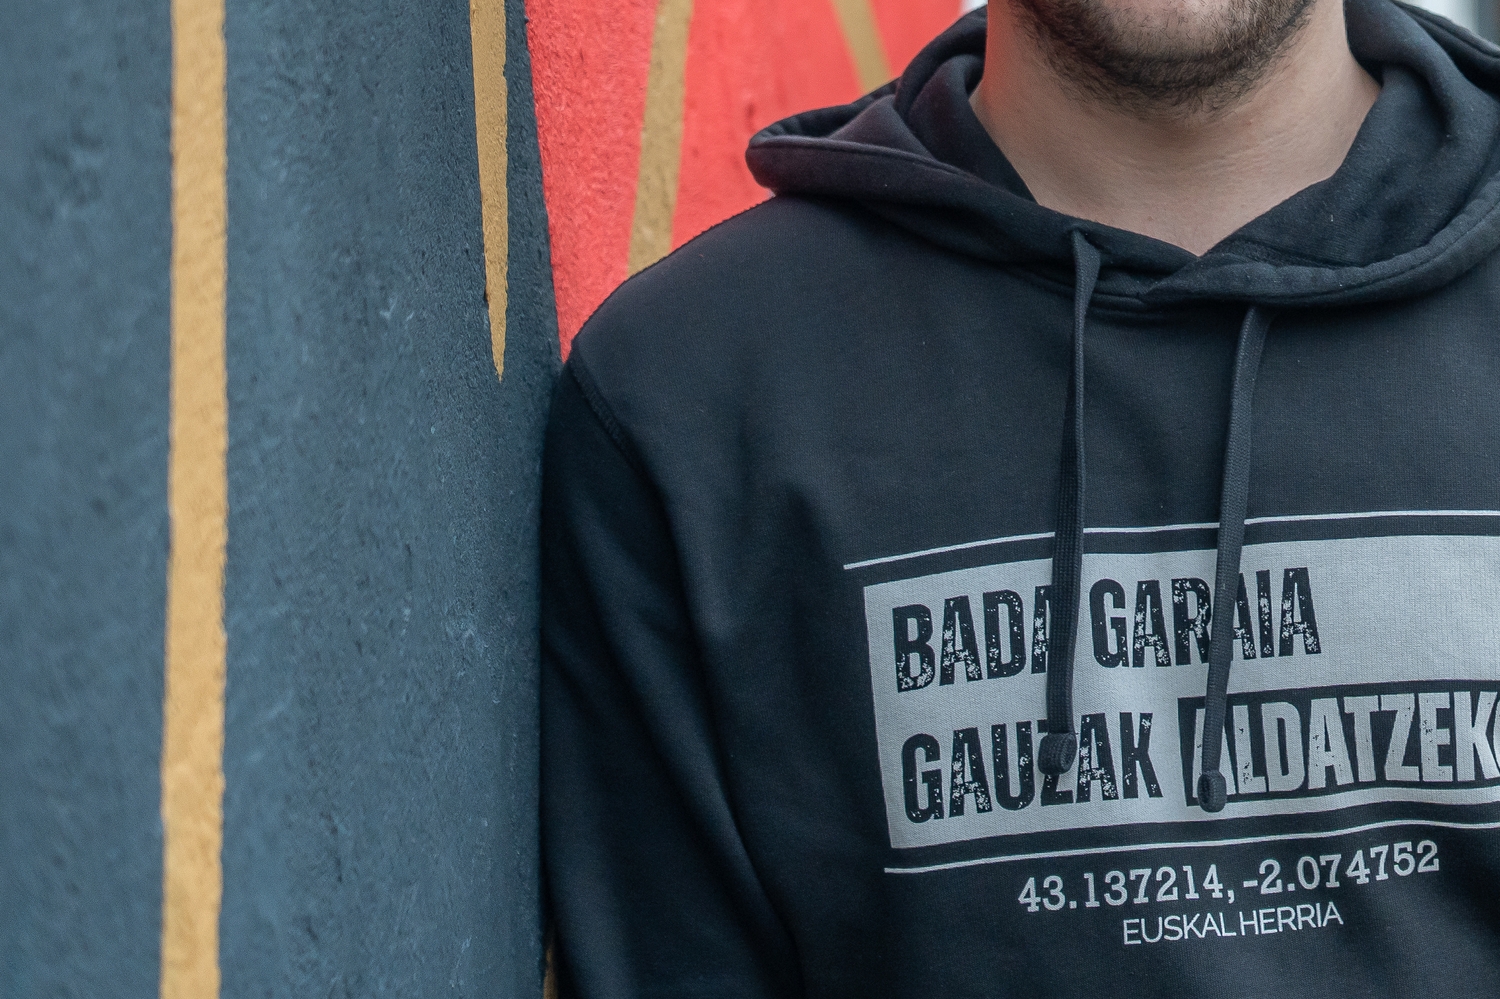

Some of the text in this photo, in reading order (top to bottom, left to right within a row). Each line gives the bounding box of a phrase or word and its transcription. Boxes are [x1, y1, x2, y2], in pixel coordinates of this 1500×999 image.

[1018, 839, 1440, 912] 43.137214, -2.074752
[1123, 901, 1344, 945] EUSKAL HERRIA
